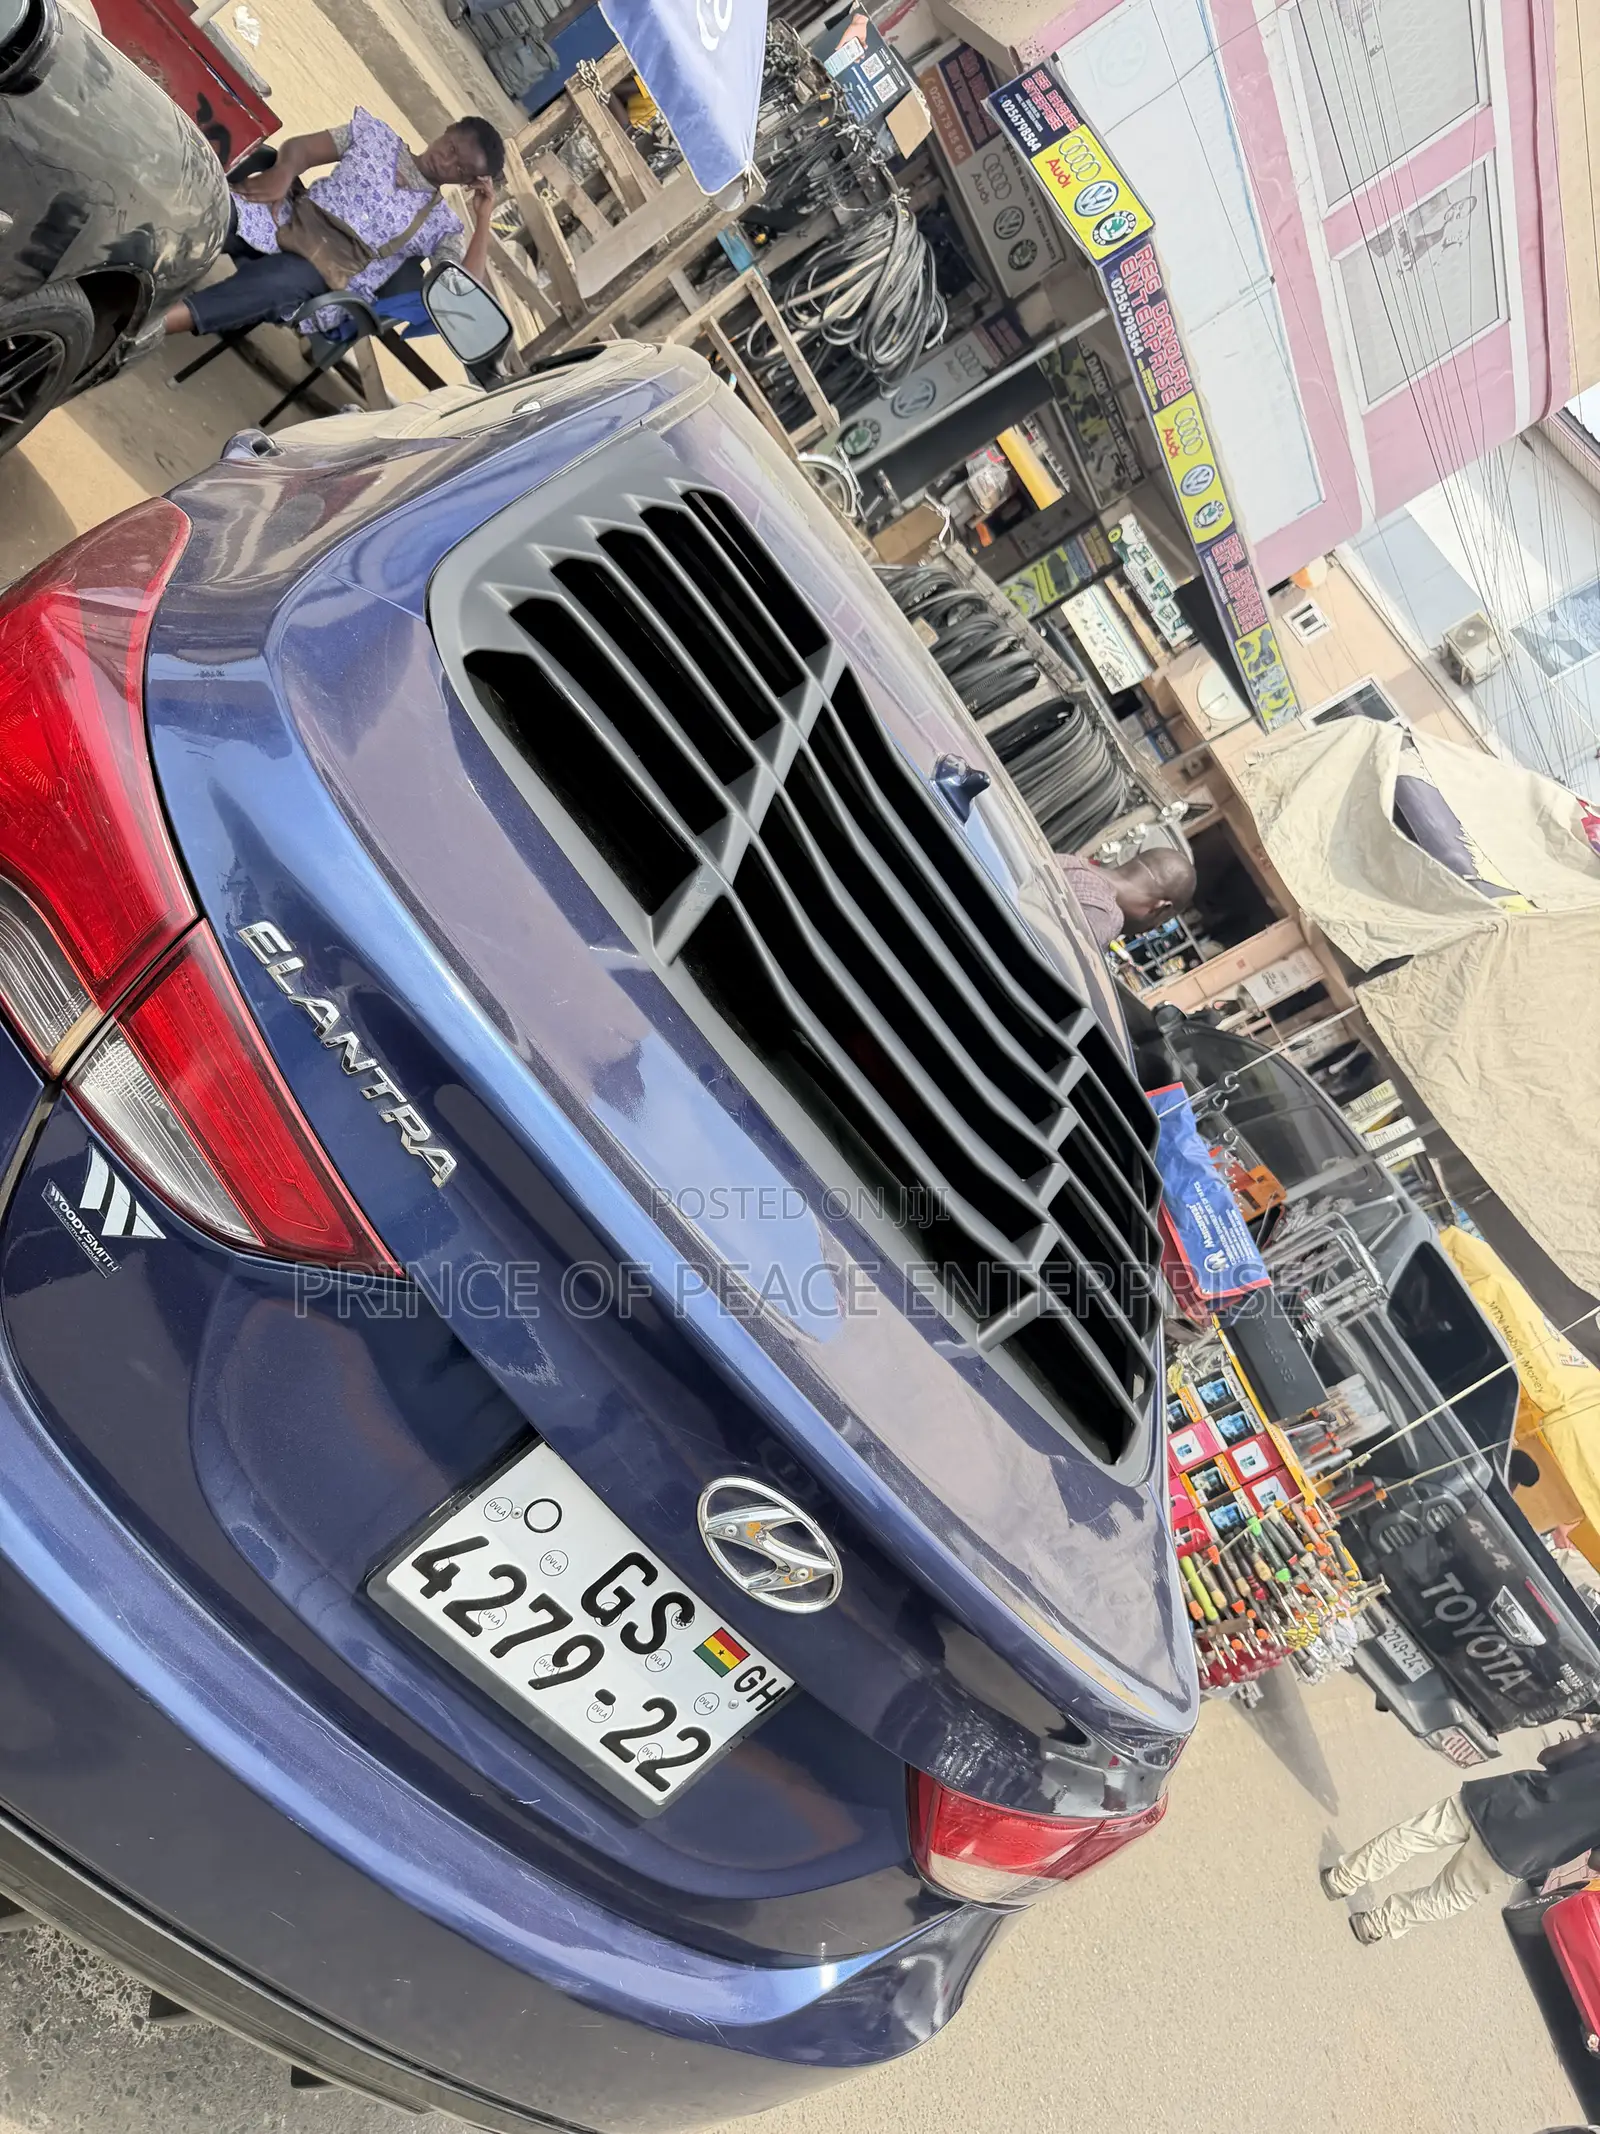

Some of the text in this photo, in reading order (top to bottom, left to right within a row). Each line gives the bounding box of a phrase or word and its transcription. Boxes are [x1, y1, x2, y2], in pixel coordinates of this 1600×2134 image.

[1001, 99, 1042, 152] 0256798564
[1021, 77, 1064, 132] ENTERPRISE
[1046, 158, 1070, 189] Audi
[1111, 277, 1144, 356] 0256798564
[1120, 256, 1178, 406] ENTERPRISE
[1135, 244, 1192, 397] REG DANQUAH
[1162, 428, 1179, 459] Audi
[238, 920, 457, 1188] ELANTRA
[51, 1185, 119, 1272] WOODYSMITH
[1188, 1204, 1216, 1249] Mansarovar
[81, 1241, 100, 1263] GROUP
[1501, 1325, 1522, 1358] Mobile
[1520, 1361, 1544, 1393] Money
[489, 1500, 507, 1517] DVLA
[544, 1554, 563, 1572] DVLA
[581, 1551, 696, 1657] GS
[1421, 1572, 1532, 1693] TOYOTA
[411, 1535, 712, 1792] 4279-22
[538, 1658, 555, 1674] DVLA
[650, 1654, 666, 1668] DVLA
[591, 1704, 608, 1719] DVLA
[699, 1697, 714, 1711] DVLA
[733, 1665, 786, 1713] GH
